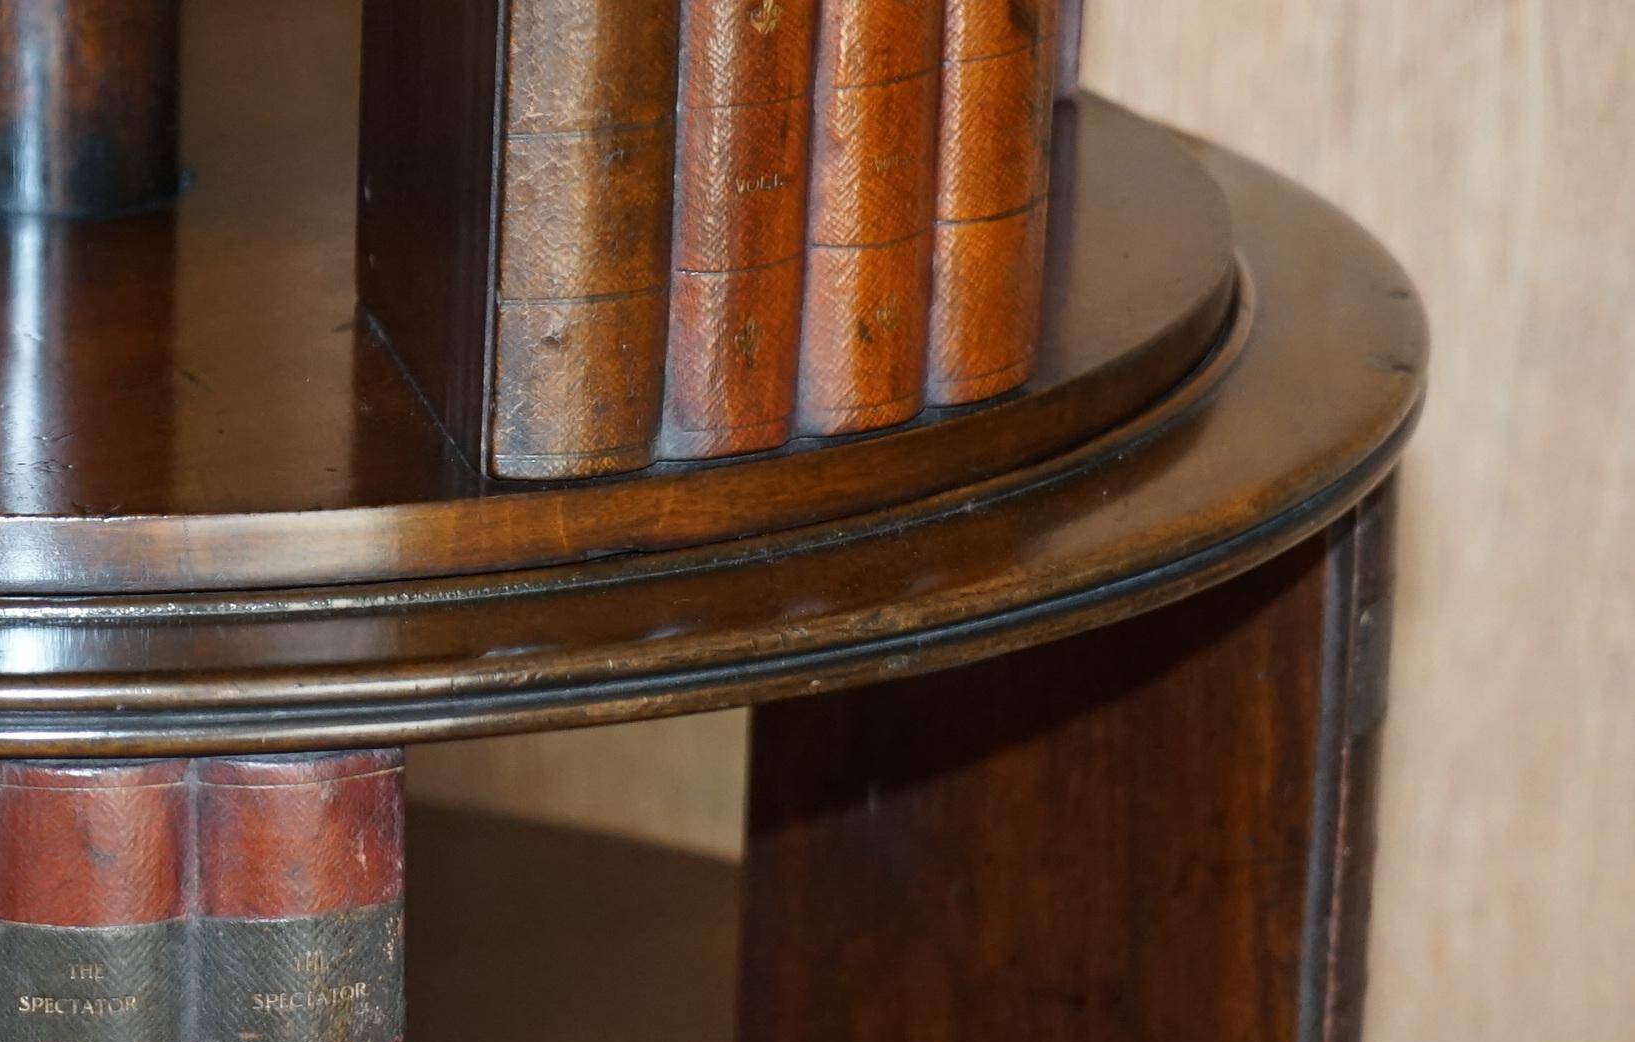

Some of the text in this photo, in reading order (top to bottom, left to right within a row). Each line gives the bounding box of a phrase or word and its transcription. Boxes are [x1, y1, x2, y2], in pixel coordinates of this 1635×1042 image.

[68, 962, 105, 981] THE
[18, 995, 137, 1016] SPECTATOR
[252, 982, 370, 1010] SPECTATOR
